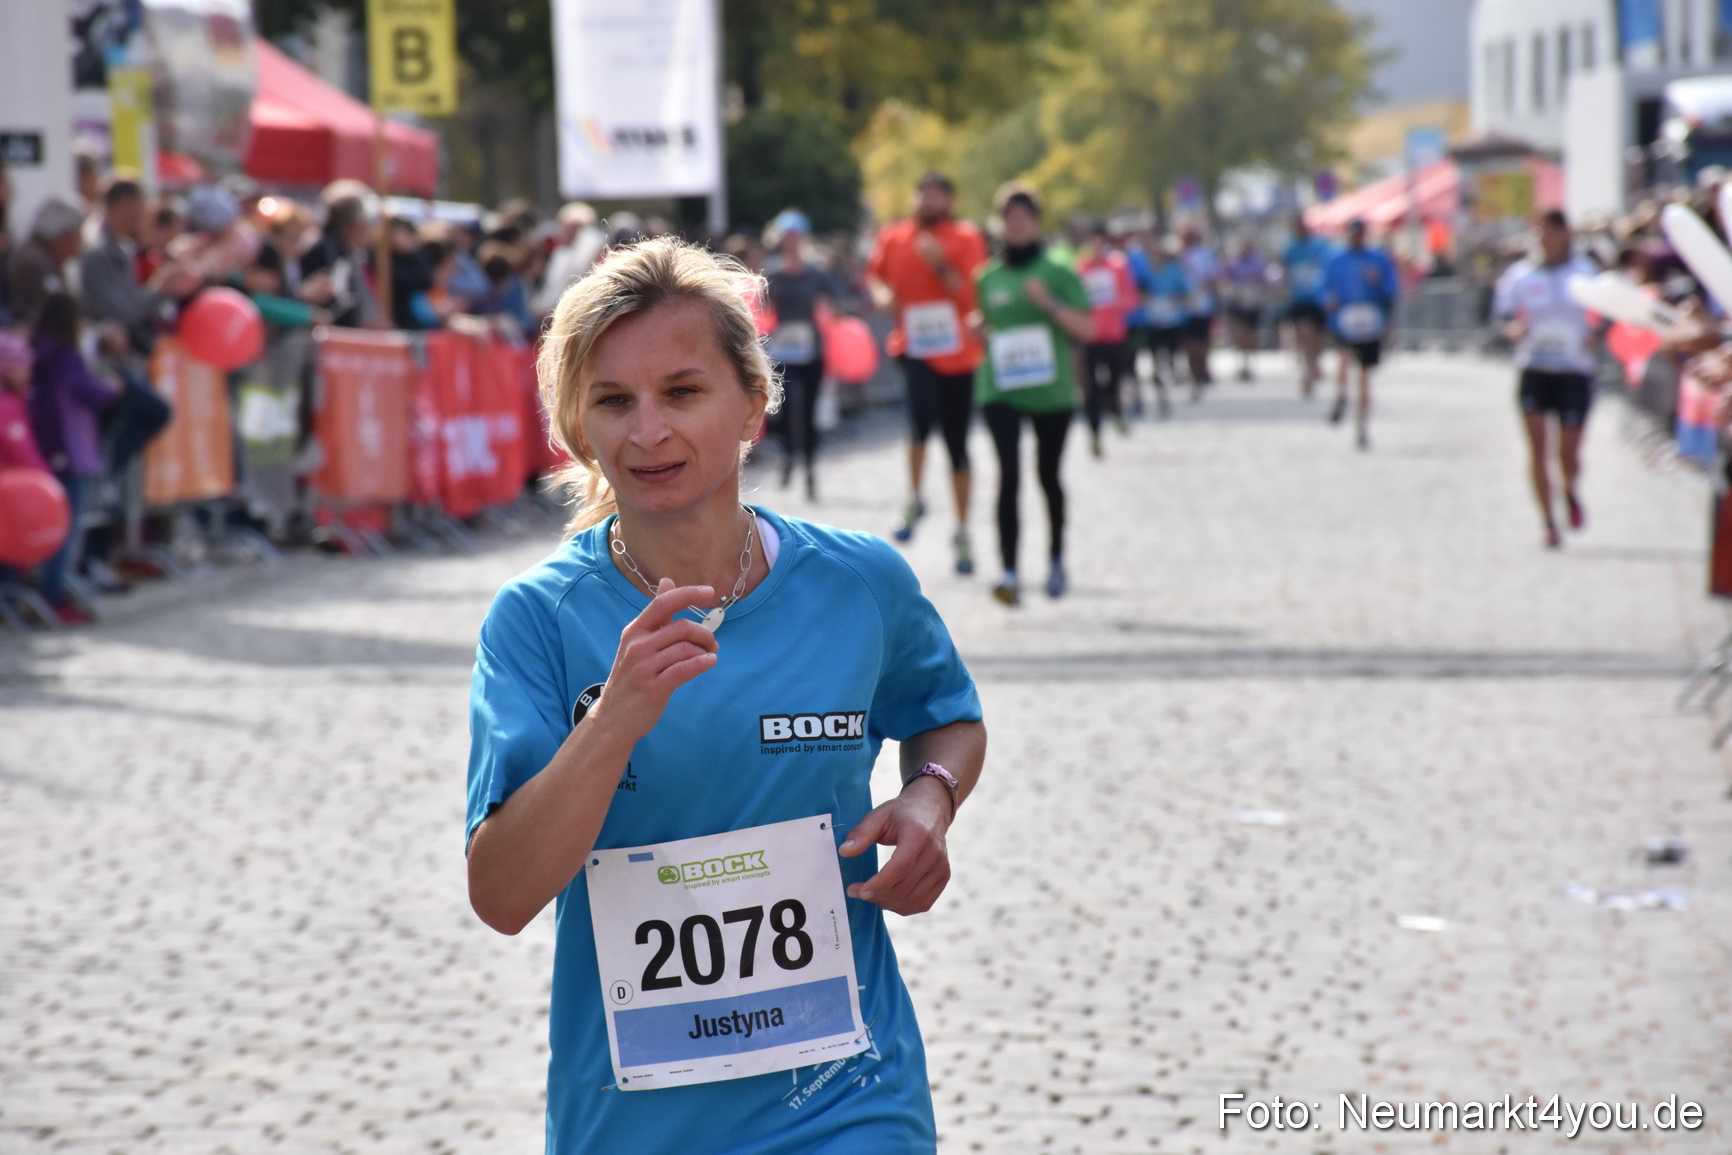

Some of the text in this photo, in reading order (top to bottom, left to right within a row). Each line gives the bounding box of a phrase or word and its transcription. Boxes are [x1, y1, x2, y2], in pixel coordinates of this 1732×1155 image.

[394, 27, 433, 83] B
[760, 710, 866, 743] BOCK
[761, 744, 800, 755] inspired
[804, 743, 815, 753] by
[817, 743, 842, 752] smart
[681, 850, 769, 882] BOCK
[684, 870, 771, 890] inspired by smart concepts
[635, 898, 814, 992] 2078
[617, 986, 626, 1000] D
[688, 1006, 785, 1040] Justyna
[788, 1056, 850, 1110] 17. Septemb
